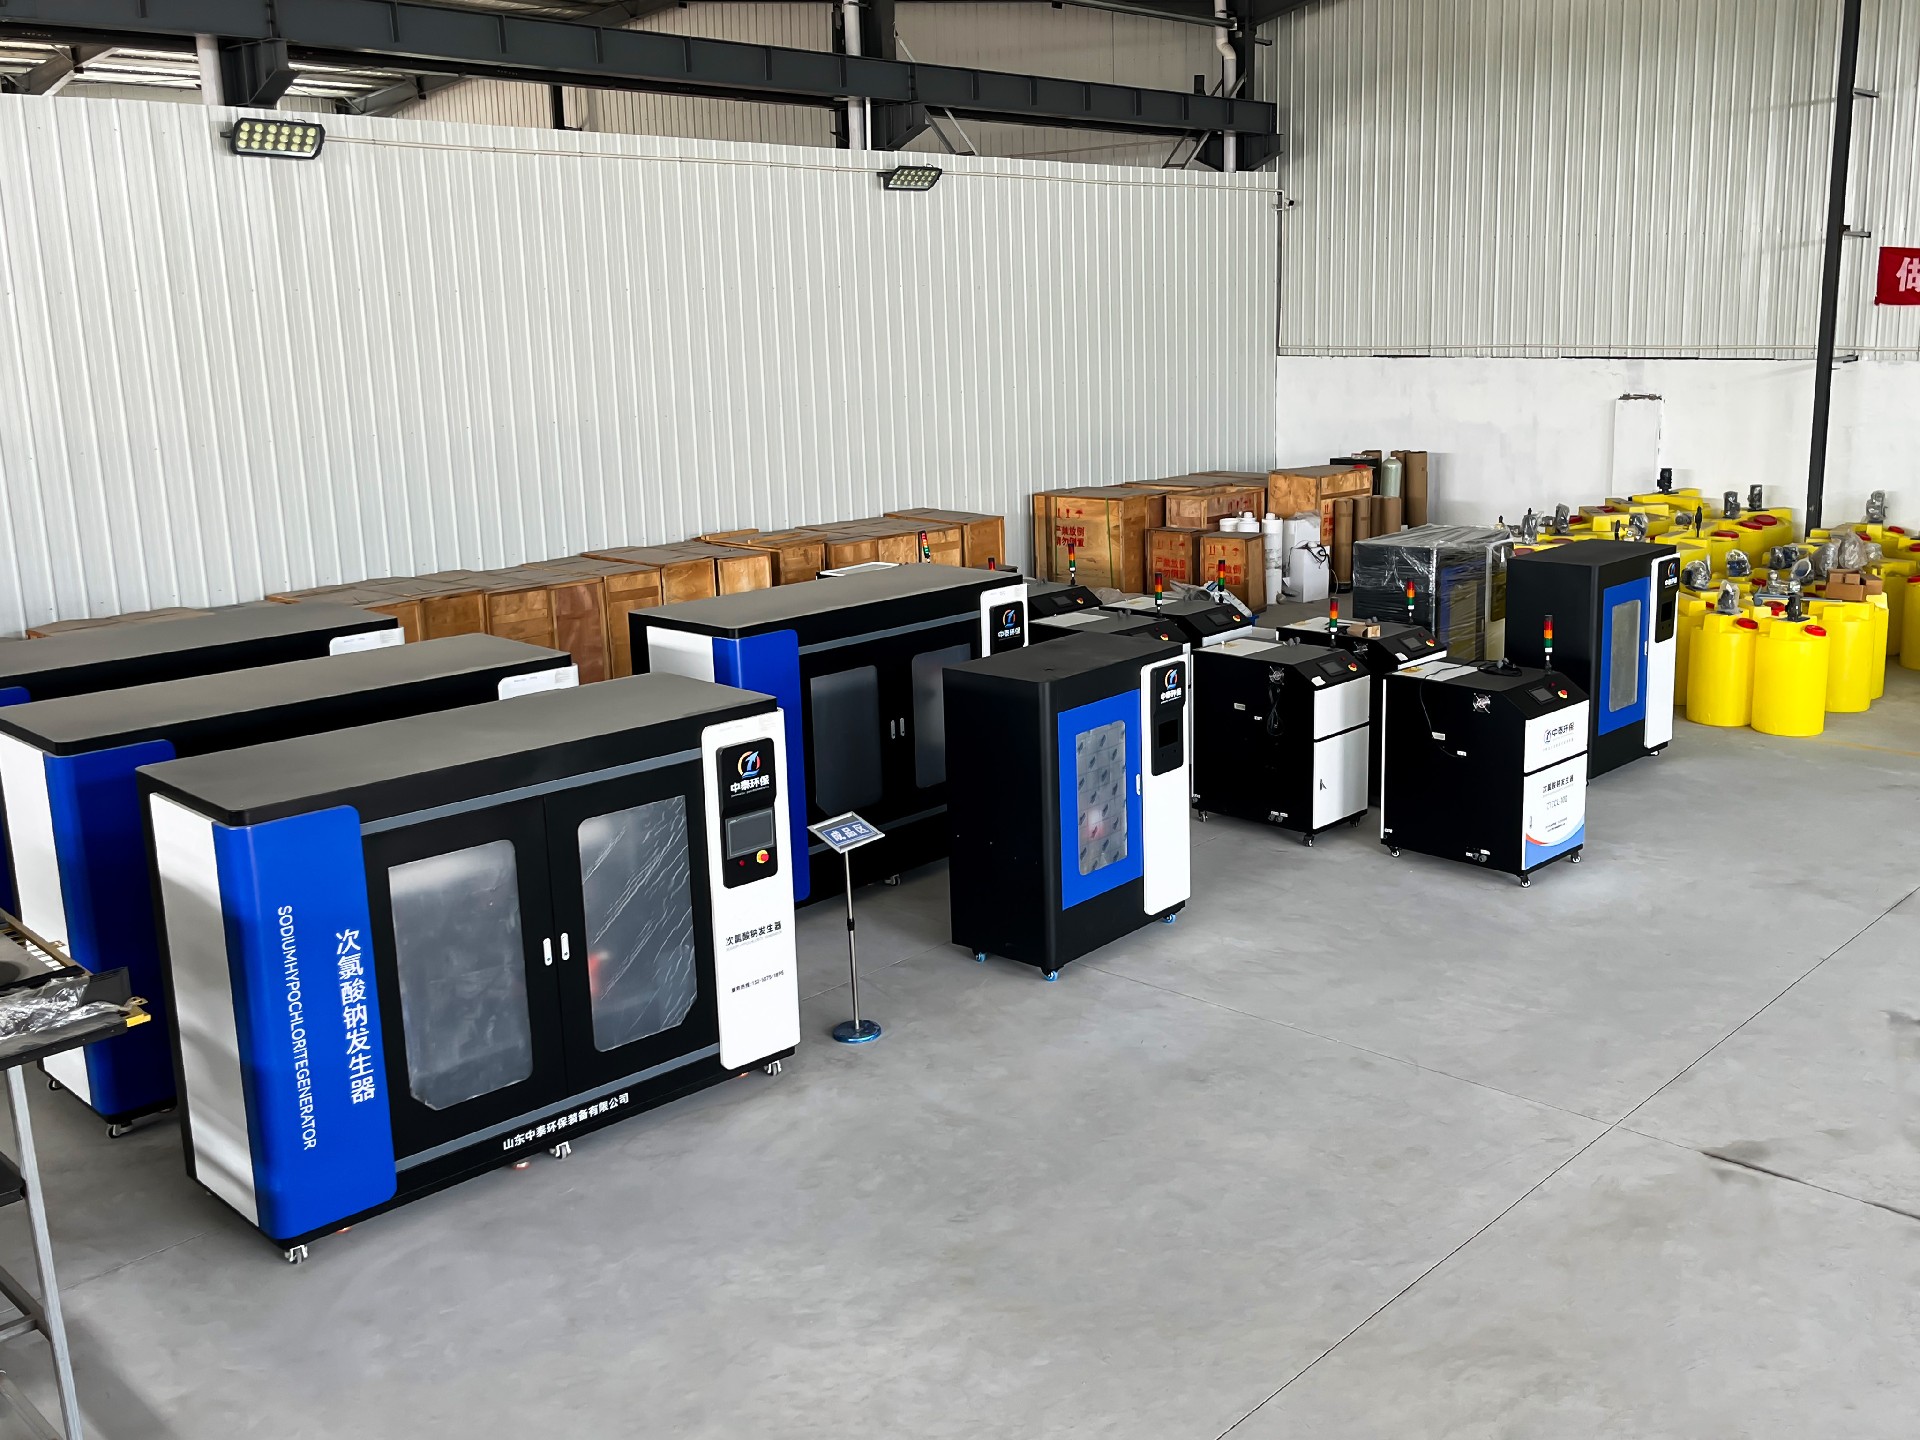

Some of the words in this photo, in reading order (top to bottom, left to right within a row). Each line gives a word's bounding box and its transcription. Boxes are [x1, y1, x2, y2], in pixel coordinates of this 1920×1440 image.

[1207, 562, 1242, 575] 严放倒
[730, 774, 770, 793] 中泰环保
[830, 823, 870, 842] 成品区
[278, 905, 317, 1151] SODIUMHYPOCHLORITEGENERATOR
[335, 928, 376, 1105] 次氯酸钠发生器
[503, 1092, 630, 1151] 山东中泰环保装备有限公司
